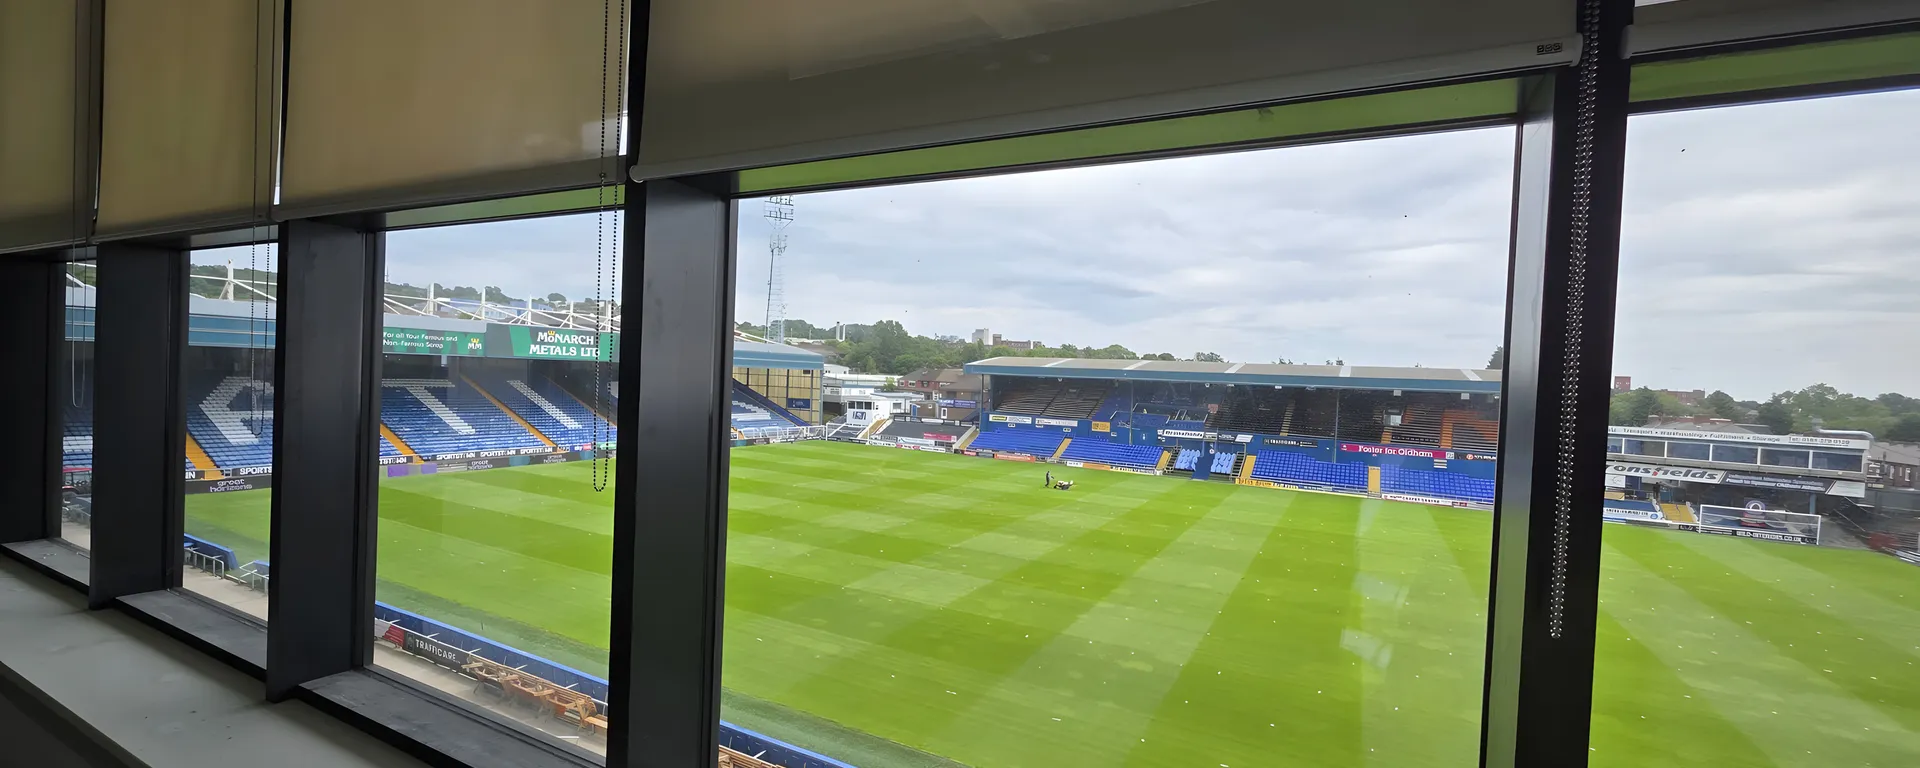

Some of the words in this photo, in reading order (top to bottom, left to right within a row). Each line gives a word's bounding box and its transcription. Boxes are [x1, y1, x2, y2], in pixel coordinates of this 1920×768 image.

[529, 344, 577, 356] METALS
[581, 347, 600, 357] LTD
[1398, 448, 1433, 458] Oldham
[1613, 465, 1718, 480] onsfields
[217, 478, 245, 487] great
[209, 484, 253, 493] horizons
[415, 638, 456, 660] TRAFFICARE
